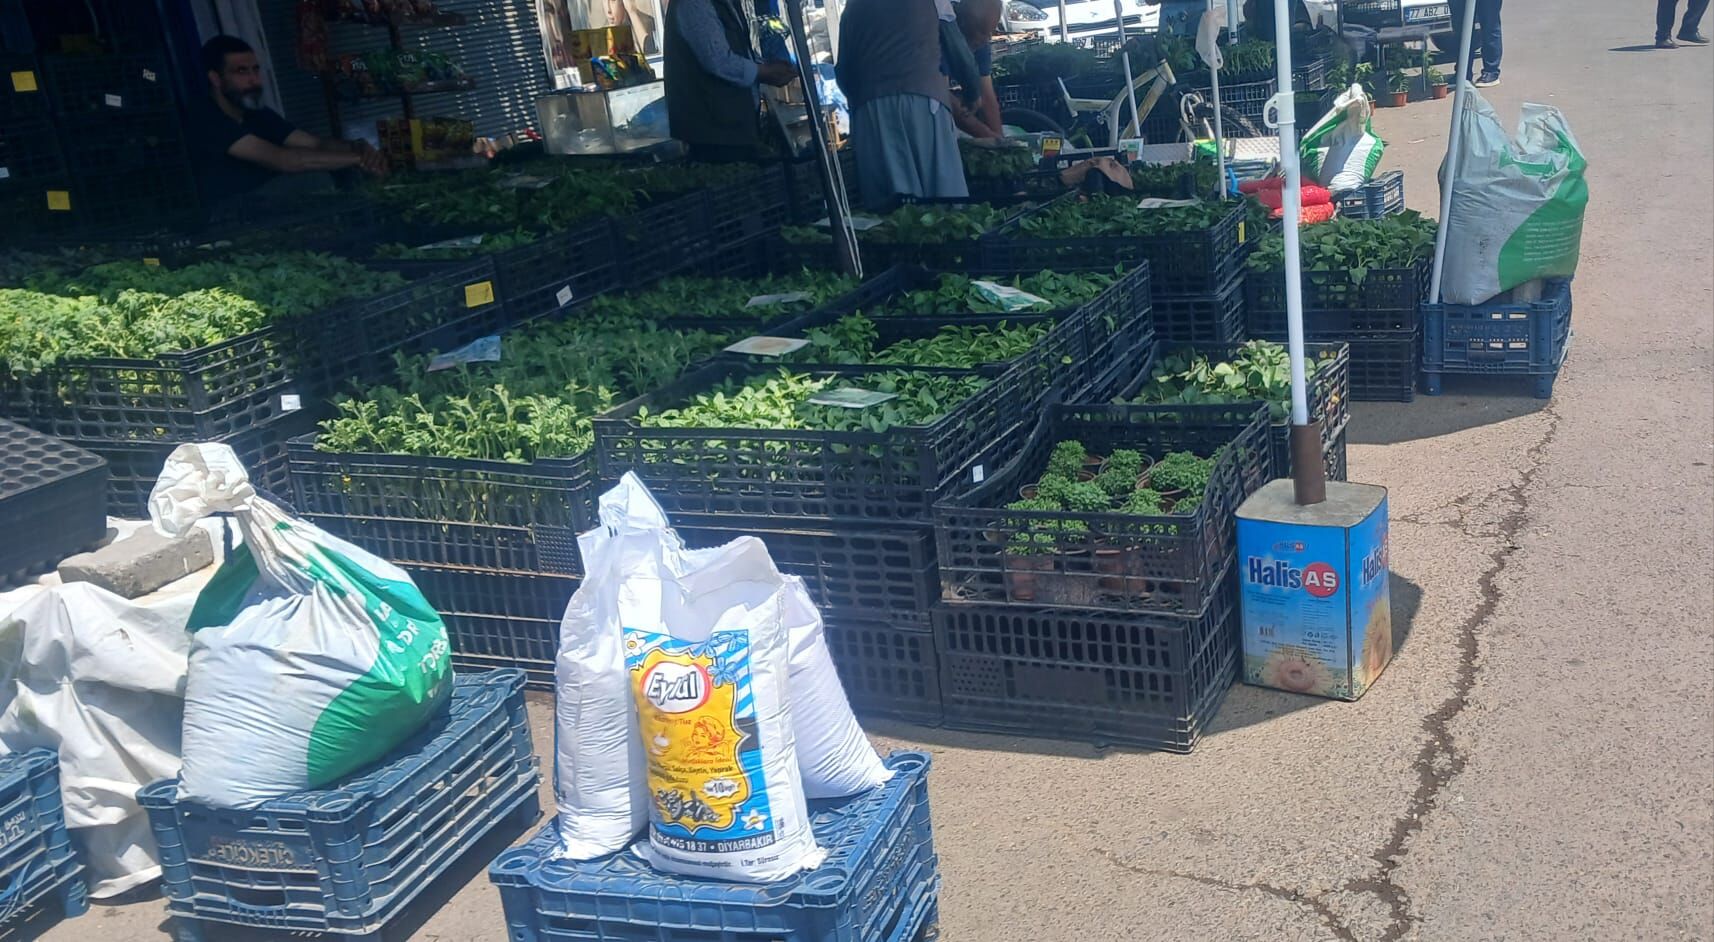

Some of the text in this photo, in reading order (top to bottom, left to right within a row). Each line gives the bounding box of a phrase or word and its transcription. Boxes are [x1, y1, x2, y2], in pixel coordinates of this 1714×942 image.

[1410, 8, 1420, 18] 77
[1424, 6, 1438, 17] ABZ
[1248, 556, 1302, 590] Halis
[647, 671, 698, 706] Eylül
[717, 834, 774, 852] DİYARBAKIR
